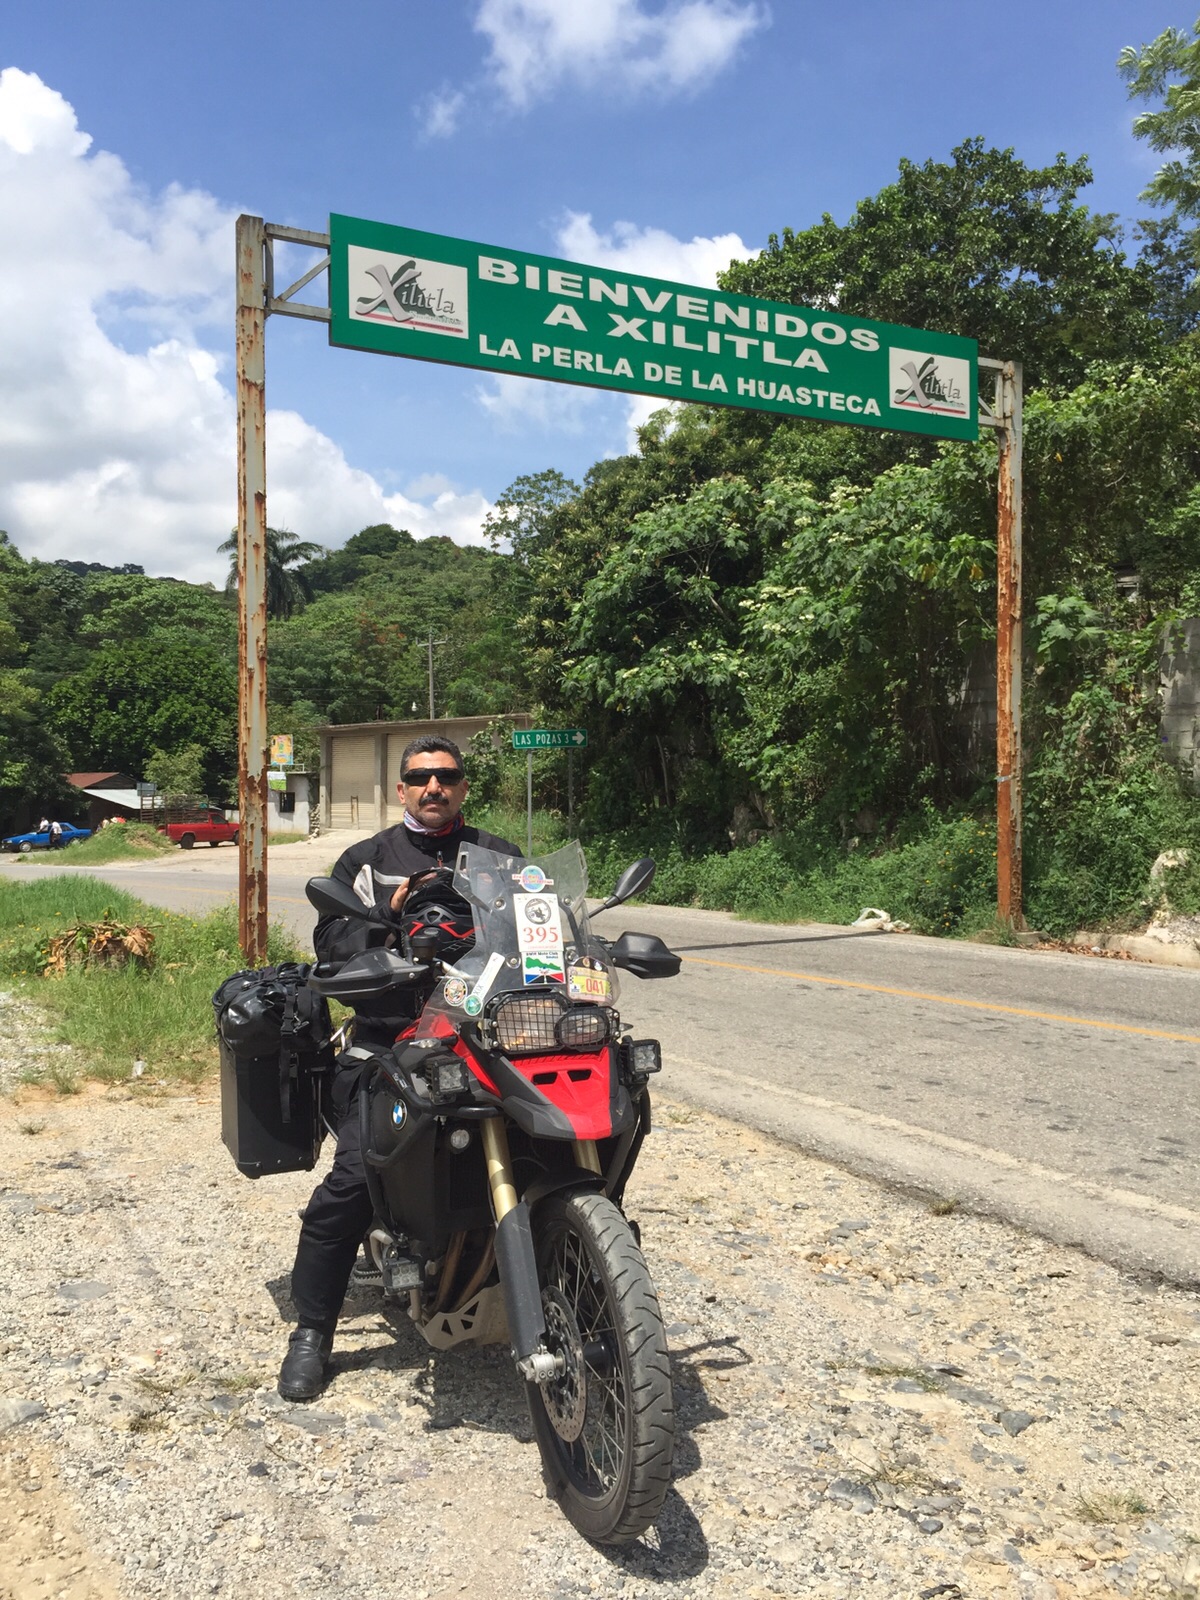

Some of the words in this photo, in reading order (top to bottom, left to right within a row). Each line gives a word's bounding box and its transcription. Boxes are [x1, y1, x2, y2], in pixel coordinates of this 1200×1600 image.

[478, 255, 880, 352] BIENVENIDOS
[543, 303, 588, 332] A
[607, 313, 830, 373] XILITLA
[479, 333, 522, 360] LA
[532, 342, 634, 378] PERLA
[644, 361, 682, 386] DE
[692, 369, 729, 393] LA
[737, 377, 881, 417] HUASTECA
[515, 734, 531, 745] LAS
[536, 733, 562, 744] POZAS
[564, 733, 569, 743] 3
[523, 926, 559, 943] 395
[585, 978, 605, 995] 041
